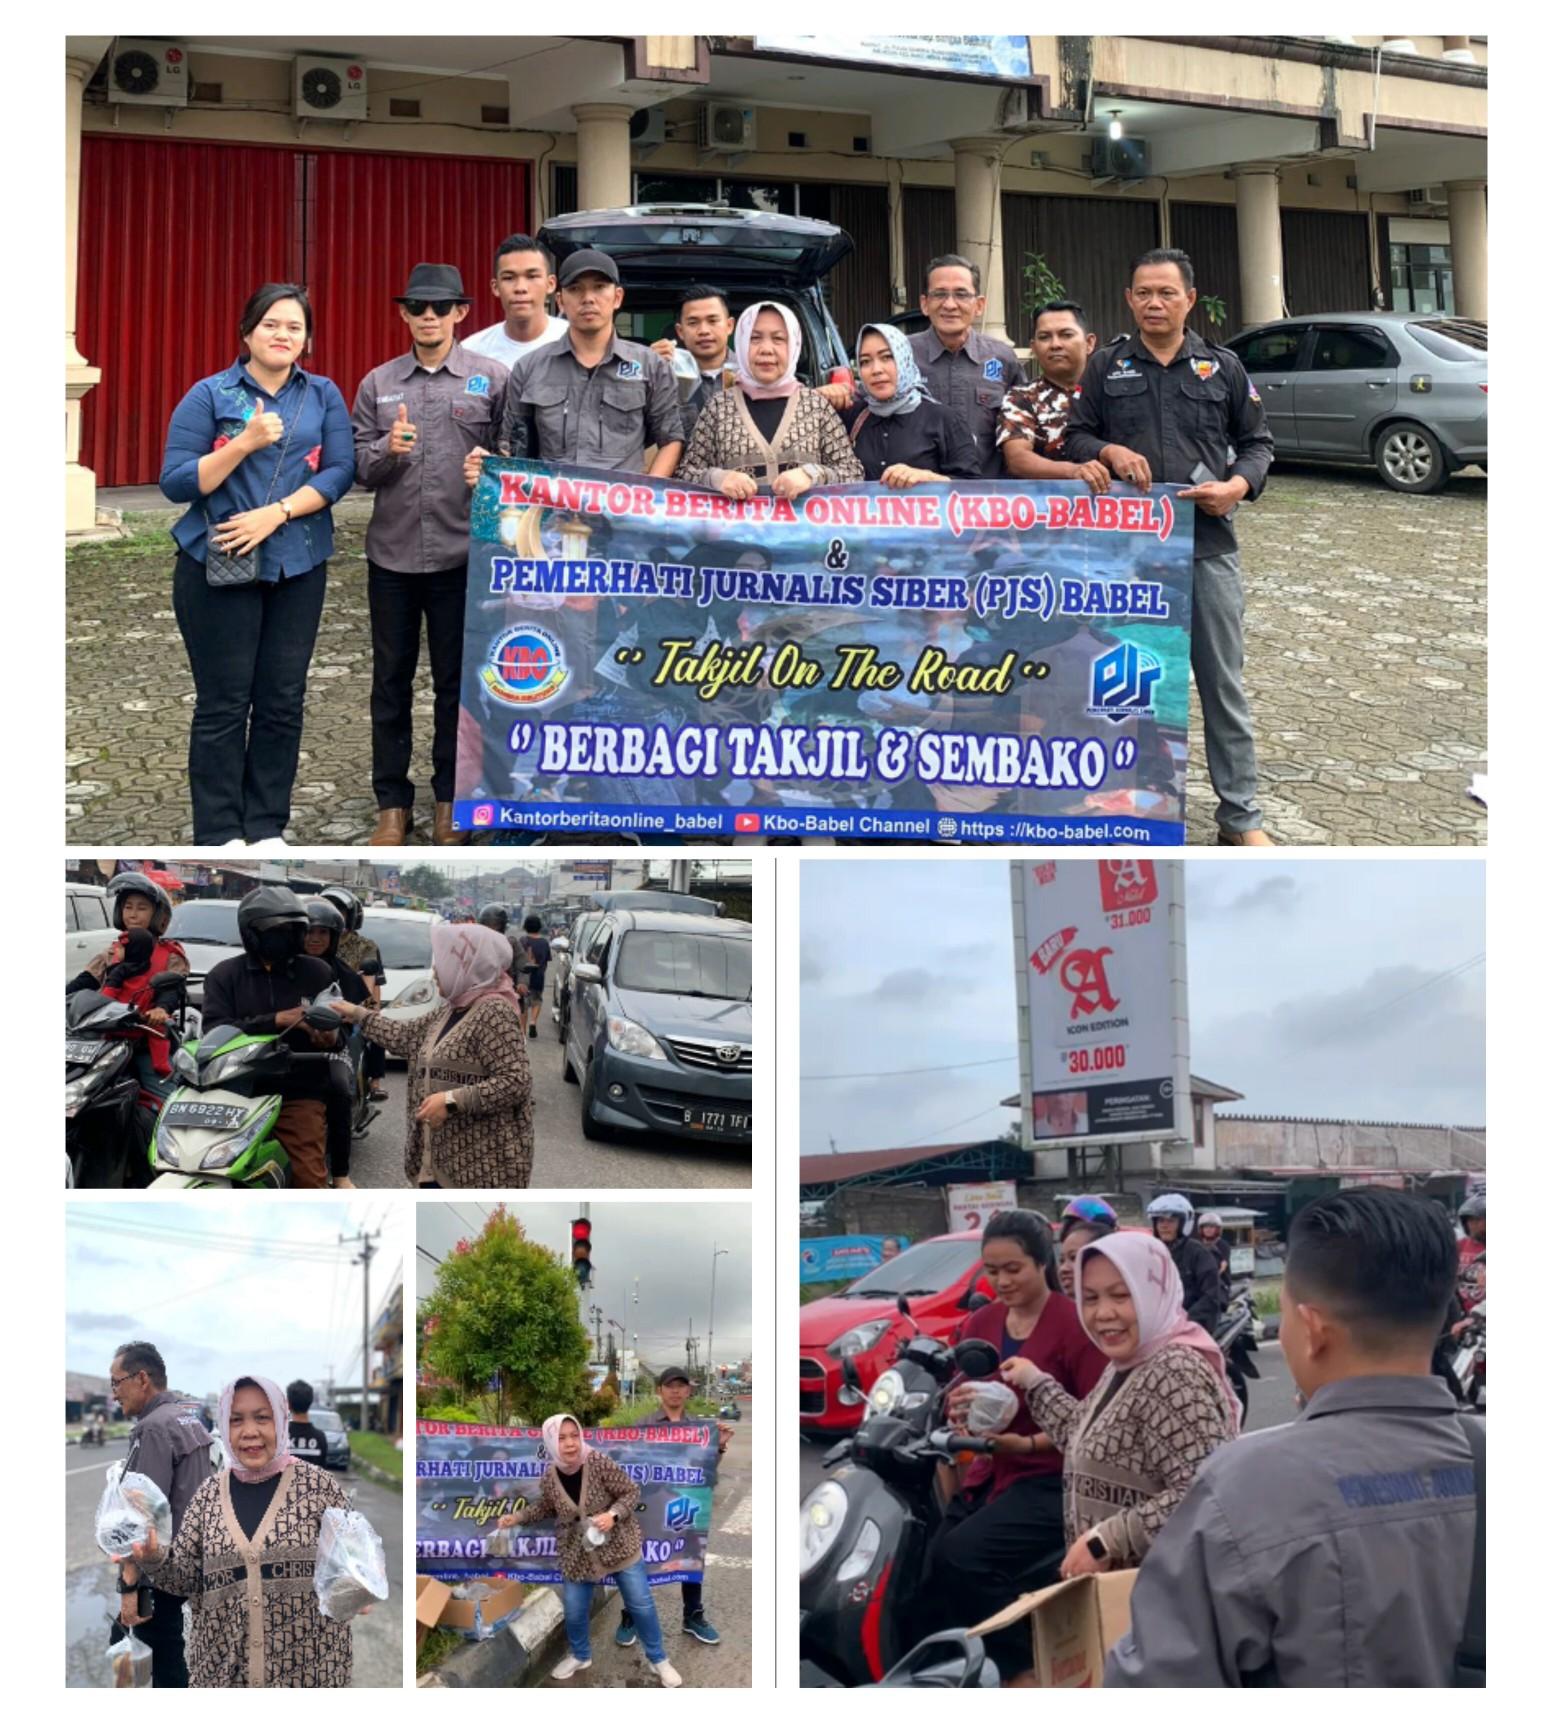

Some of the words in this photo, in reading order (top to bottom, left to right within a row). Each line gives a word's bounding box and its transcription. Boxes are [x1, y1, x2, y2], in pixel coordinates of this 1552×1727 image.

[166, 66, 181, 74] LG
[500, 474, 656, 516] KANTOR
[664, 490, 798, 524] BERITA
[804, 495, 939, 528] ONLINE
[947, 491, 1174, 541] (KBO-BABEL)
[825, 539, 849, 569] &
[490, 558, 694, 598] PEMERHATI
[698, 568, 865, 607] JURNALIS
[870, 577, 968, 611] SIBER
[975, 573, 1055, 621] (PJS)
[1061, 581, 1168, 617] BABEL
[502, 646, 548, 681] KBO
[654, 640, 762, 698] Takjil
[770, 643, 821, 687] On
[830, 647, 900, 690] The
[909, 647, 1017, 692] Road
[541, 724, 718, 776] BERBAGI
[728, 727, 868, 779] TAKJIL
[877, 731, 909, 779] &
[917, 733, 1106, 787] SEMBAKO
[500, 807, 723, 832] Kantorberitaonline_babel
[763, 813, 854, 831] Kbo-Babel
[859, 816, 930, 834] Channel
[961, 821, 1005, 838] https
[1009, 823, 1150, 841] ://kbo-babel.com
[1110, 907, 1151, 930] 31.000
[1066, 1024, 1089, 1035] ICON
[1090, 1017, 1129, 1033] EDITION
[1068, 1044, 1126, 1073] 30.000
[169, 1103, 187, 1116] BN
[188, 1102, 224, 1116] 6922
[455, 1423, 522, 1437] BERITA
[596, 1425, 710, 1449] (KBO-BABEL)
[652, 1465, 705, 1486] BABEL
[452, 1496, 508, 1526] Takjil
